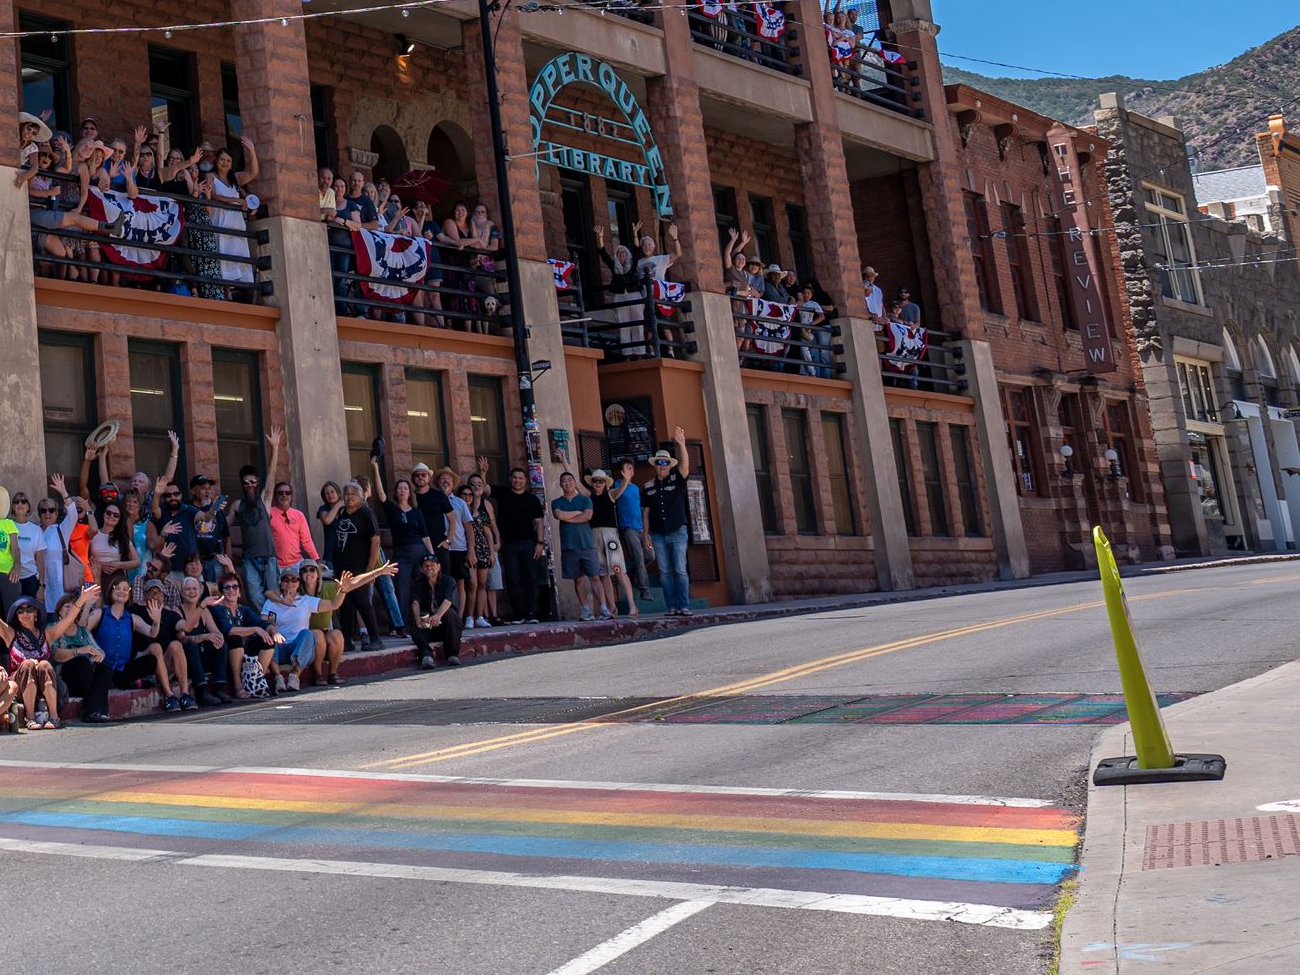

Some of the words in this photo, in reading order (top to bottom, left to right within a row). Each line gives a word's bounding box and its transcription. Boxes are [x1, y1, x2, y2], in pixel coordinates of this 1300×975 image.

[529, 52, 593, 148] OPPER
[599, 62, 674, 216] QUEEN
[546, 141, 648, 185] LIBRARY
[1053, 142, 1076, 205] THE
[1068, 227, 1106, 363] REVIEW
